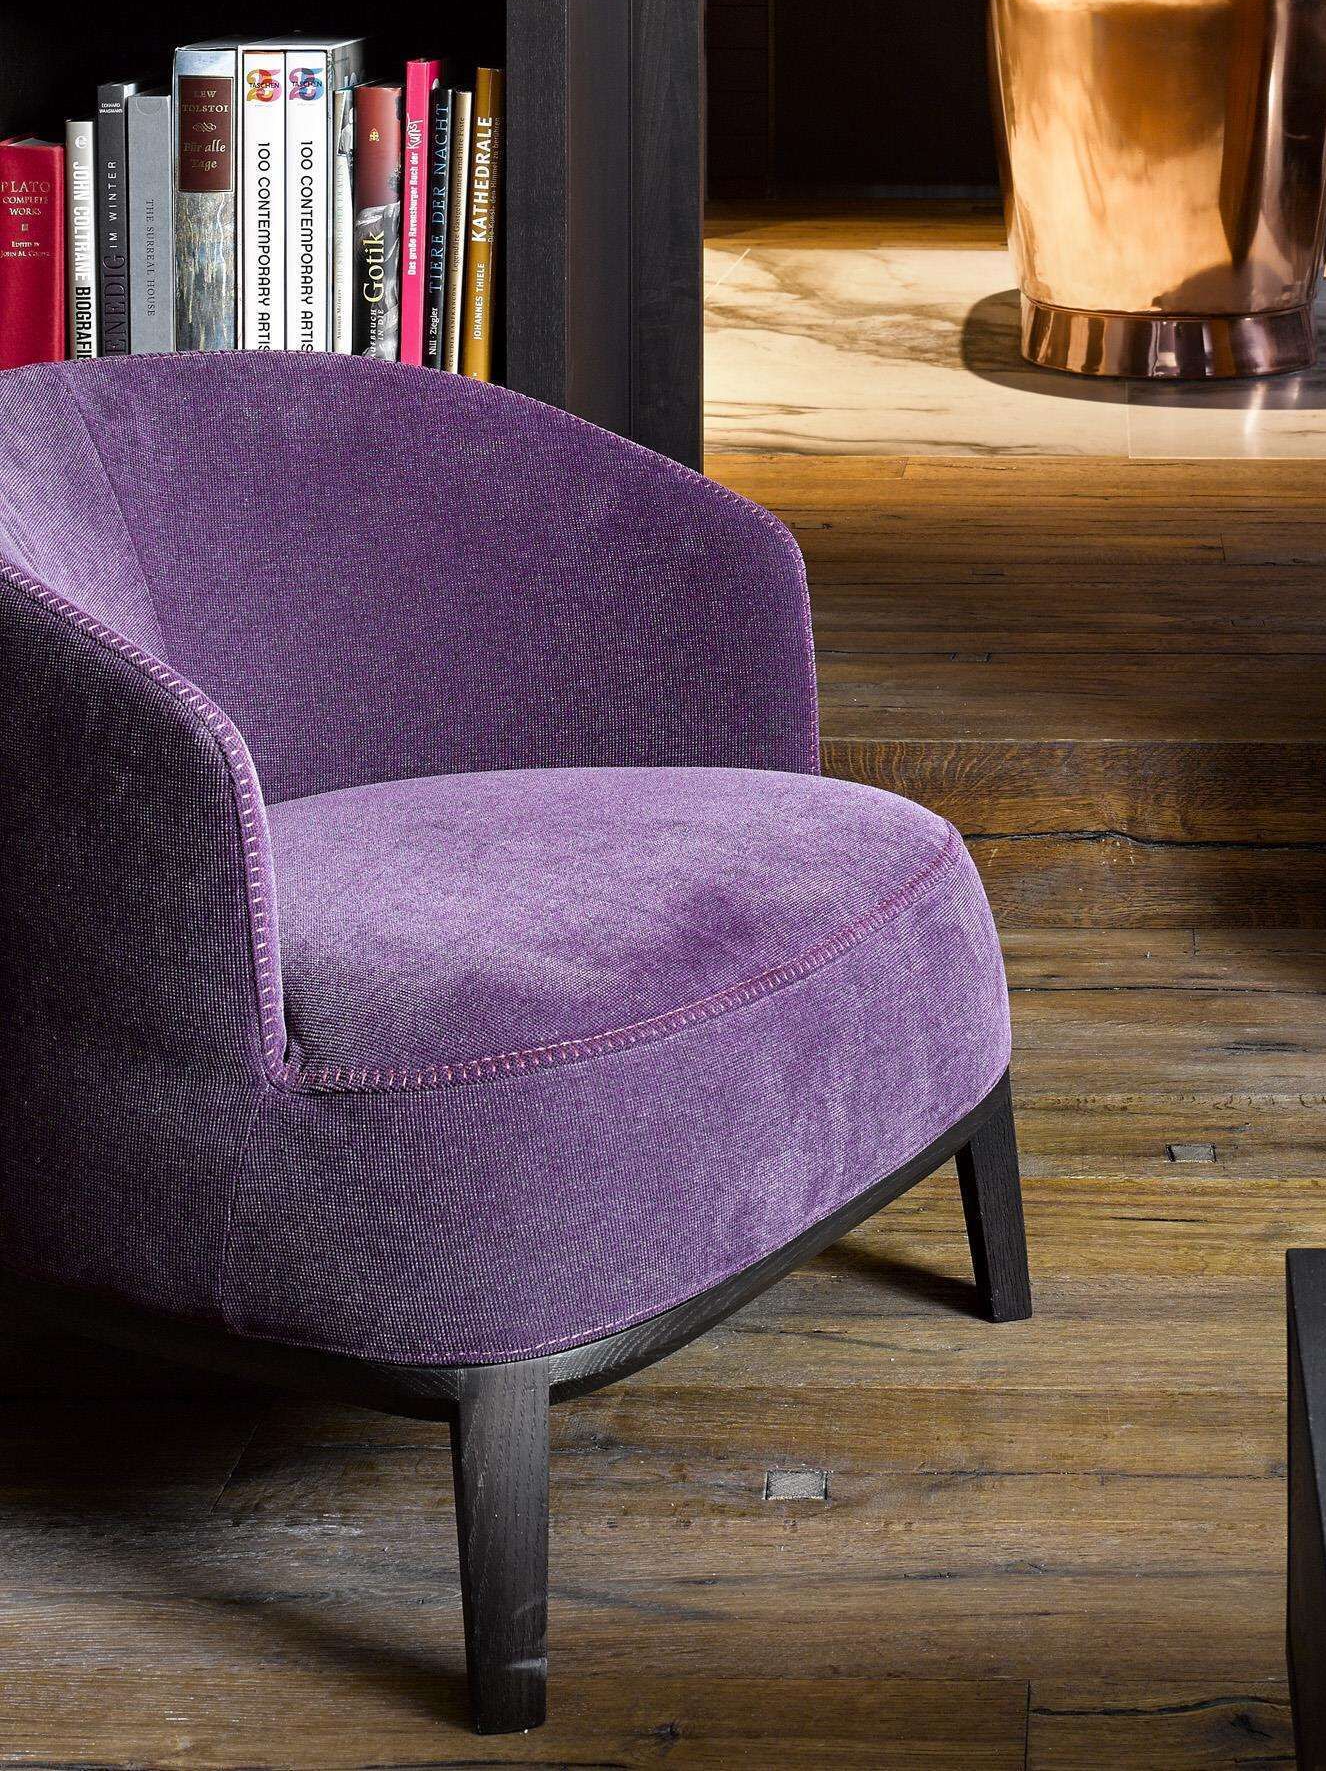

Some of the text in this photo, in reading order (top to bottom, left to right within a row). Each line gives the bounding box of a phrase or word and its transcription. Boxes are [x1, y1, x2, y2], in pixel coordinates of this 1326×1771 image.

[249, 82, 280, 90] TASCHEN
[1, 180, 50, 194] PLATO
[258, 141, 271, 172] 100
[300, 140, 314, 170] 100
[429, 103, 449, 294] TIERE DER NACHT
[471, 116, 493, 243] KATHEDRALE
[72, 161, 91, 282] JOHN COLTRANE
[107, 161, 118, 249] IM WINTER
[257, 176, 271, 306] CONTEMPORARY
[300, 175, 314, 305] CONTEMPORARY
[145, 198, 156, 317] THE SURREAL HOUSE
[362, 230, 385, 304] Gotik
[472, 262, 485, 341] JOHANNES THIELE
